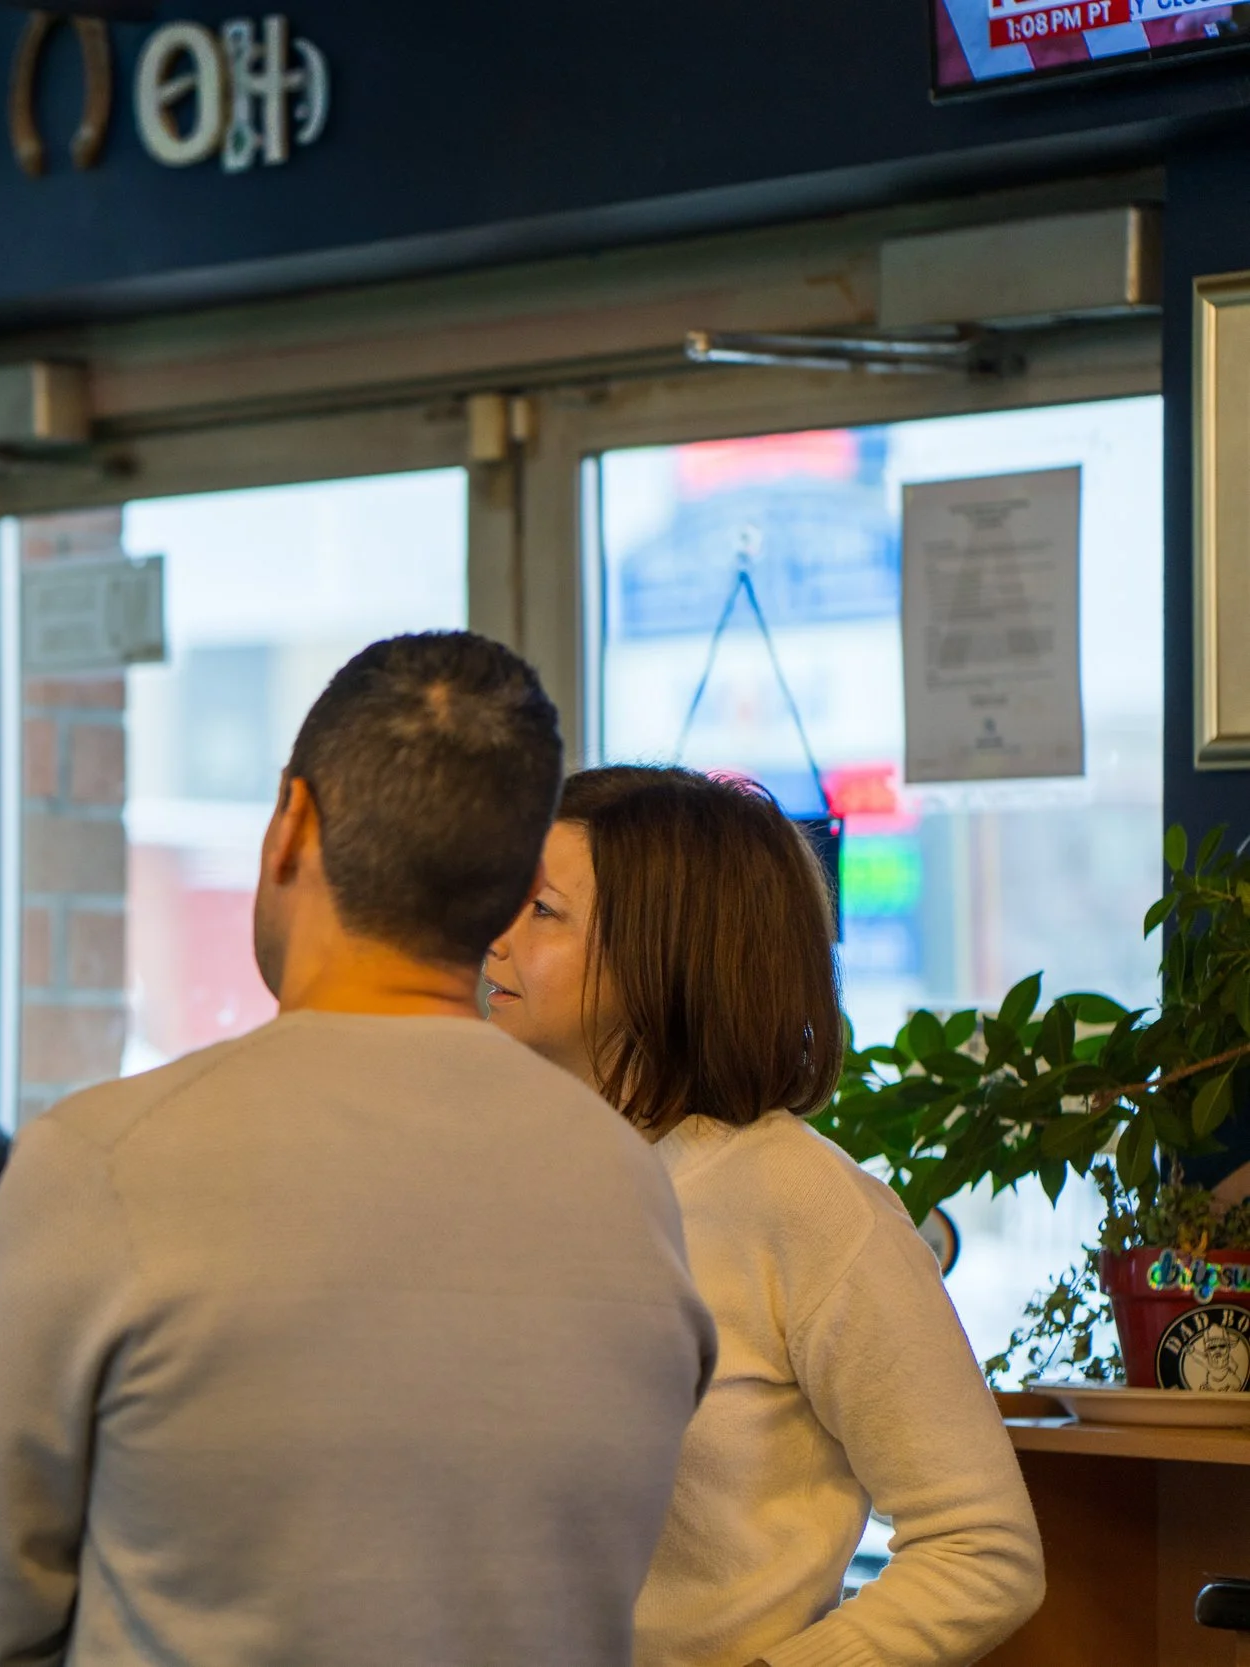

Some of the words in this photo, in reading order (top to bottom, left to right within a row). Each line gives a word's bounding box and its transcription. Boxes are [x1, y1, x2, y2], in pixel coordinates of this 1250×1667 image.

[1006, 12, 1049, 41] 1:08
[1051, 6, 1083, 33] PM
[1087, 0, 1112, 25] PT
[1164, 1312, 1209, 1355] DAD
